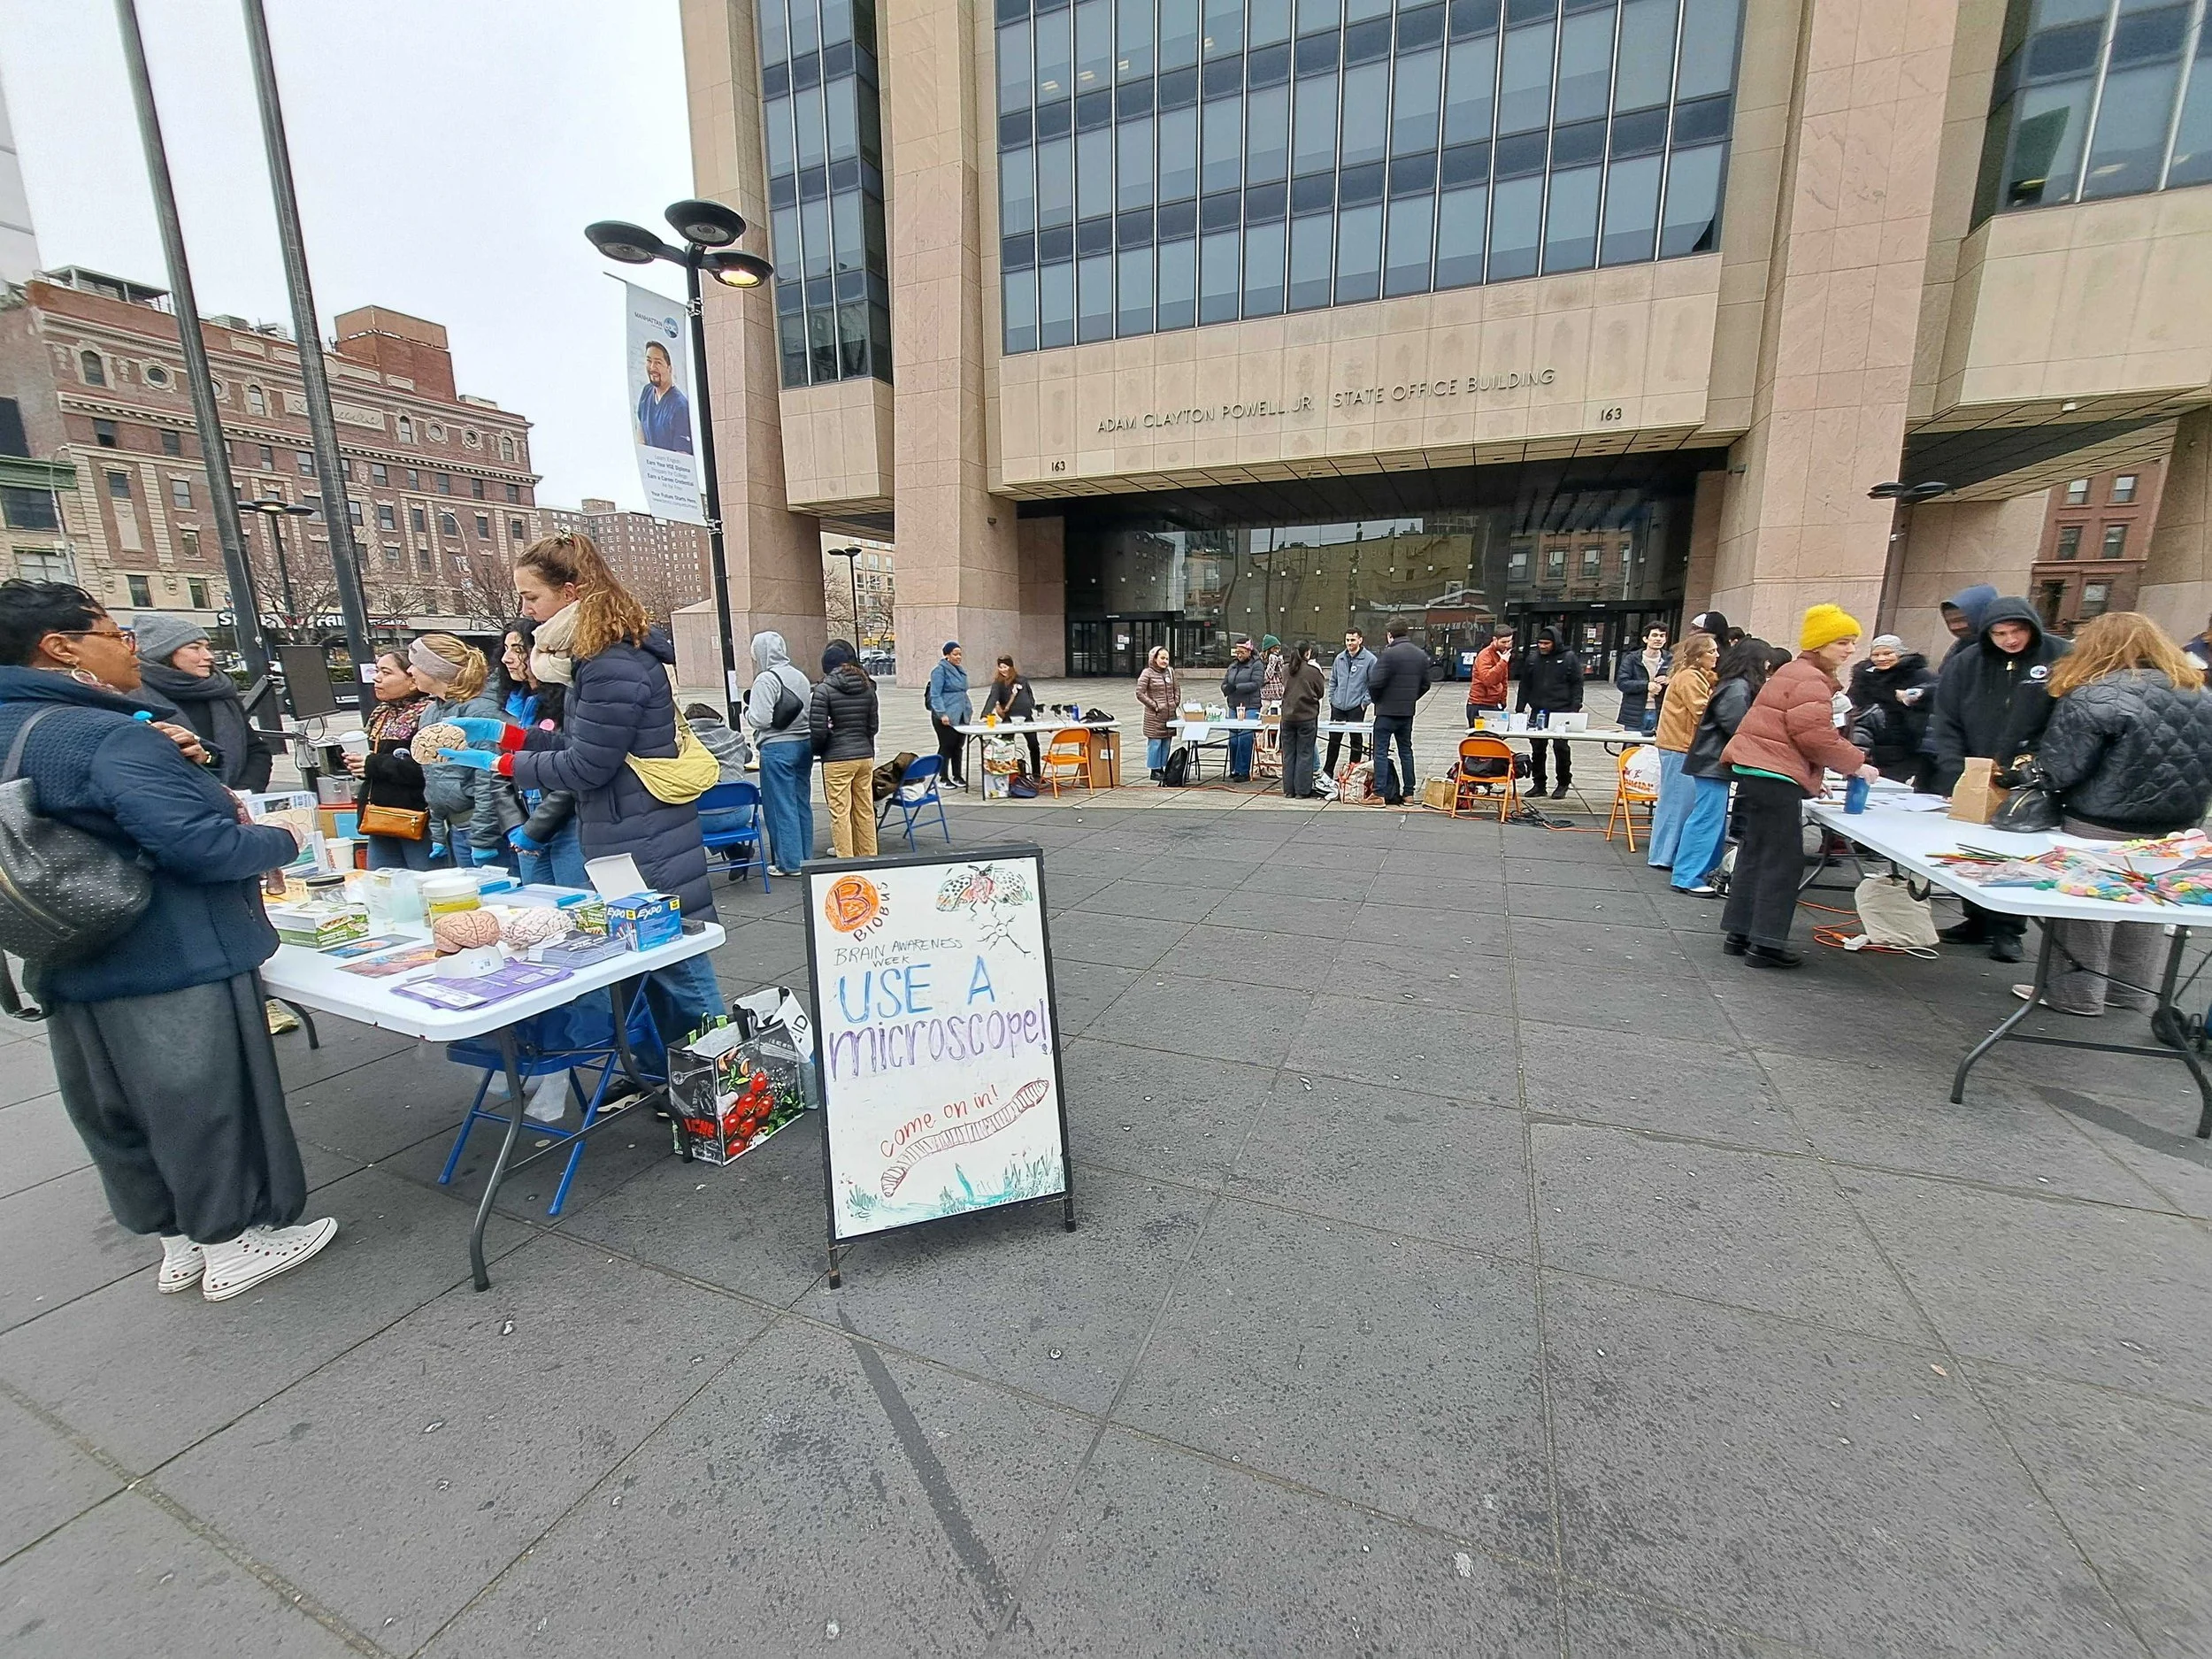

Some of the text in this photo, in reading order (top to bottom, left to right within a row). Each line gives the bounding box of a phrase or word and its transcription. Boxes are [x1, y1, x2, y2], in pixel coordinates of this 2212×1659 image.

[634, 311, 663, 326] MANHATTAN
[1096, 416, 1137, 433] ADAM
[1142, 406, 1215, 428] CLAYTON
[1333, 387, 1384, 408] STATE
[1391, 379, 1458, 401] OFFICE
[1466, 368, 1555, 394] BUILDING
[1600, 407, 1623, 422] 163
[1051, 461, 1065, 472] 163
[834, 882, 872, 926] B
[607, 907, 625, 919] EXPO
[637, 905, 662, 920] EXPO
[834, 938, 964, 965] BRAIN AWARENESS
[872, 955, 910, 968] WEEK
[840, 955, 995, 1024] USE A
[943, 1101, 968, 1118] on
[973, 1084, 999, 1109] in!
